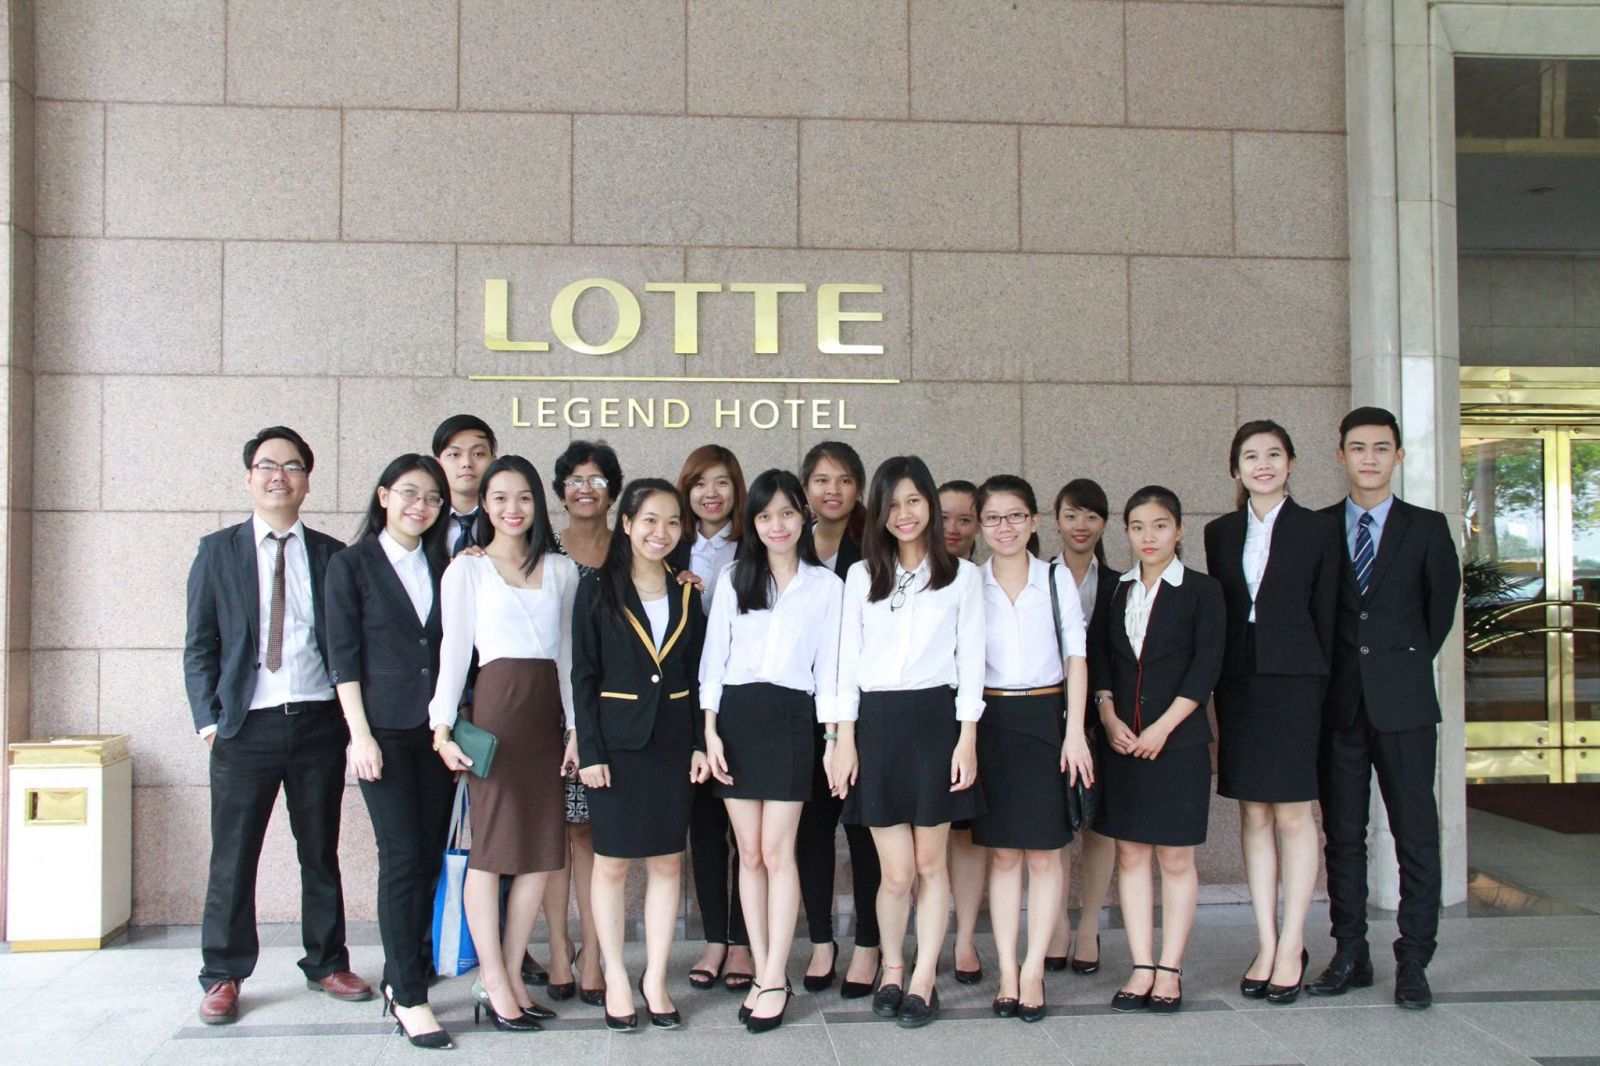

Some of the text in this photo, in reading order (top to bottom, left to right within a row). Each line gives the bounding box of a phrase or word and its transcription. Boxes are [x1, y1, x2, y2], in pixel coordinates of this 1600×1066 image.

[485, 277, 884, 355] LOTTE
[512, 397, 857, 429] LEGEND HOTEL
